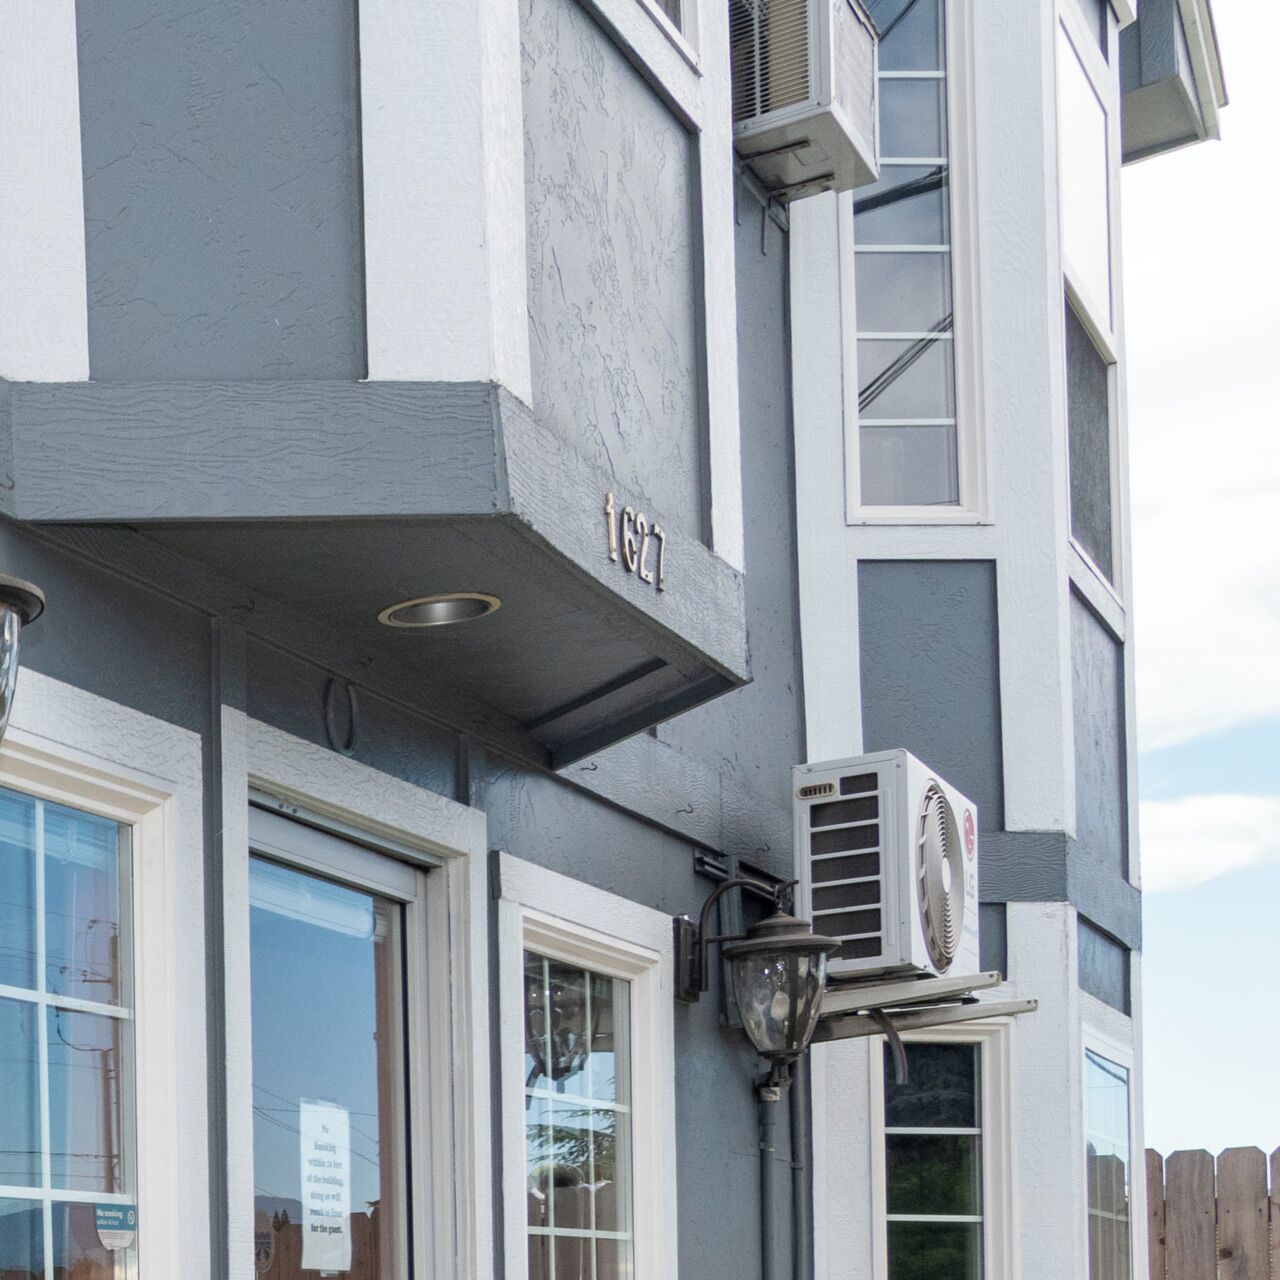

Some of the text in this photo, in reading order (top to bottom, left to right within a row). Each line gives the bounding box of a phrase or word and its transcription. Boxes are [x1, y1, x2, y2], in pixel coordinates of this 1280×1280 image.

[604, 492, 666, 592] 1627
[96, 1208, 123, 1220] No smoking
[310, 1223, 319, 1233] for
[319, 1224, 328, 1233] the
